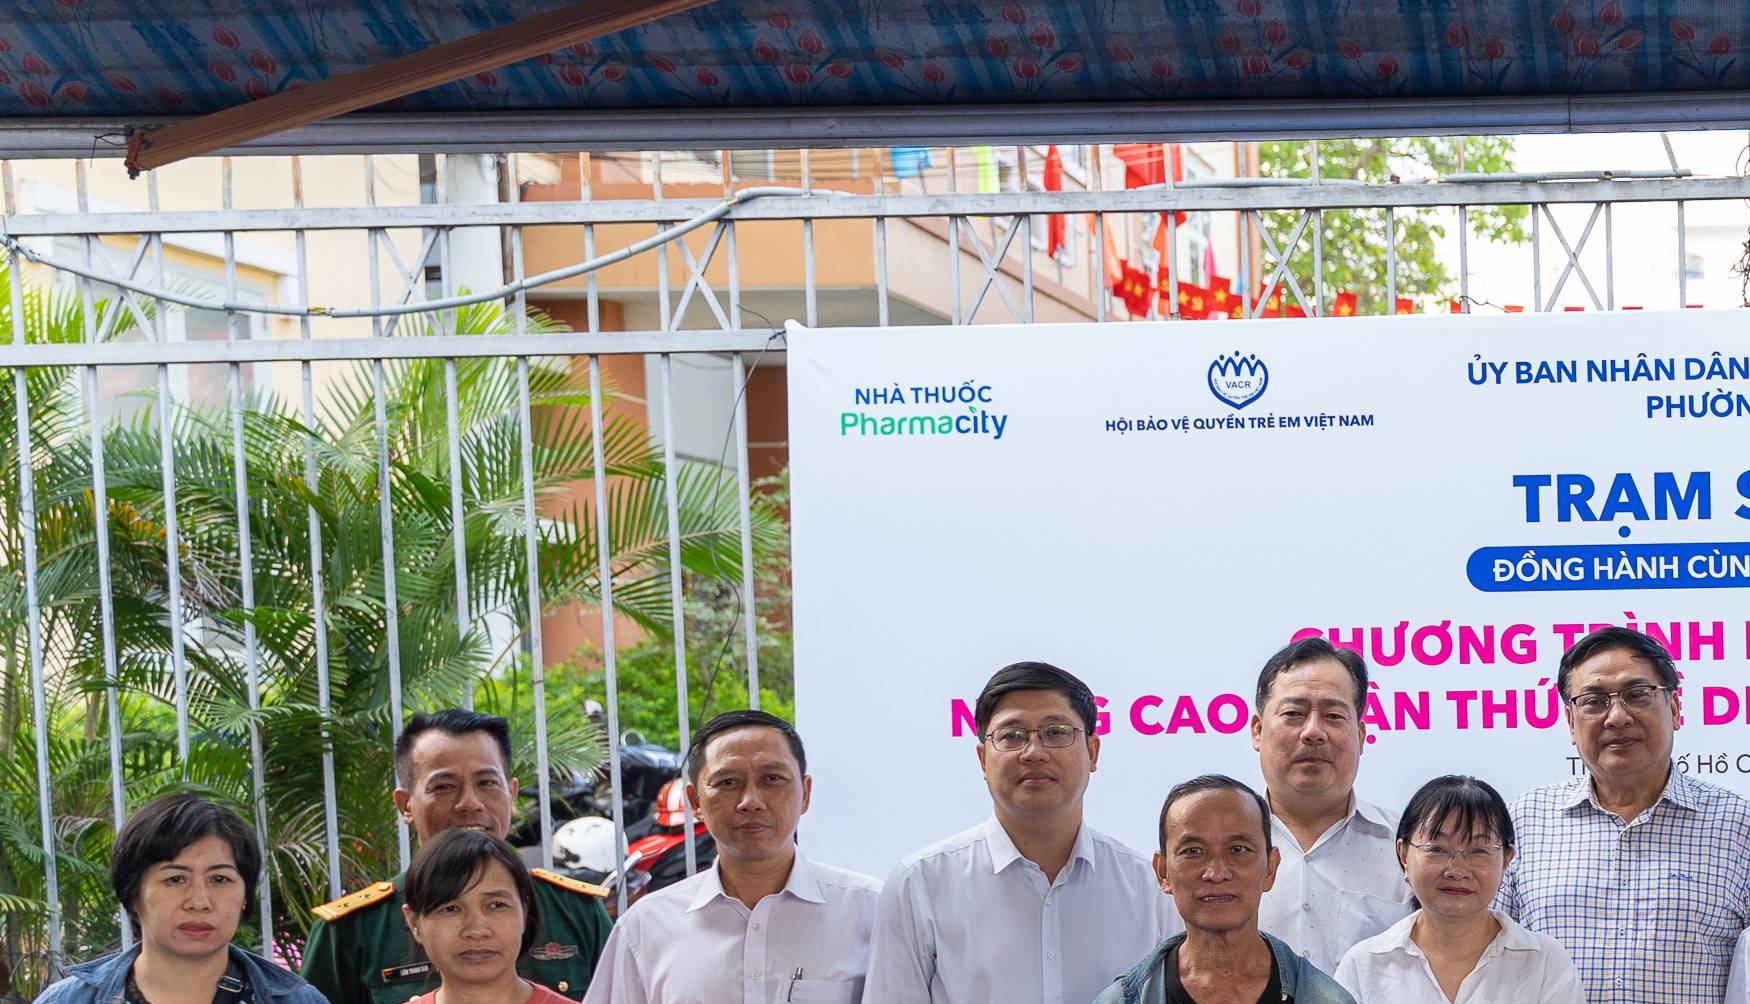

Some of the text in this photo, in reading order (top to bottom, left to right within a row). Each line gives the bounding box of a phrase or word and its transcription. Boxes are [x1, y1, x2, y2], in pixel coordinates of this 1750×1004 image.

[1468, 354, 1508, 385] ỦY
[1516, 361, 1577, 384] BAN
[1587, 353, 1673, 382] NHÂN
[1685, 352, 1749, 380] DÂN
[856, 380, 992, 404] NHÀ THUỐC
[842, 406, 1007, 439] Pharmacity
[1106, 417, 1132, 434] HỘI
[1137, 416, 1167, 430] BẢO
[1171, 416, 1189, 433] VỆ
[1248, 413, 1275, 428] TRẺ
[1279, 417, 1300, 427] EM
[1304, 413, 1335, 430] VIỆT
[1339, 415, 1373, 426] NAM
[1513, 472, 1711, 538] TRẠM
[1493, 550, 1584, 581] ĐỒNG
[1594, 551, 1678, 579] HÀNH
[1290, 620, 1538, 666] CHƯƠNG
[1129, 693, 1249, 735] CAO
[1446, 678, 1559, 731] THỨ
[1698, 752, 1729, 774] Hồ
